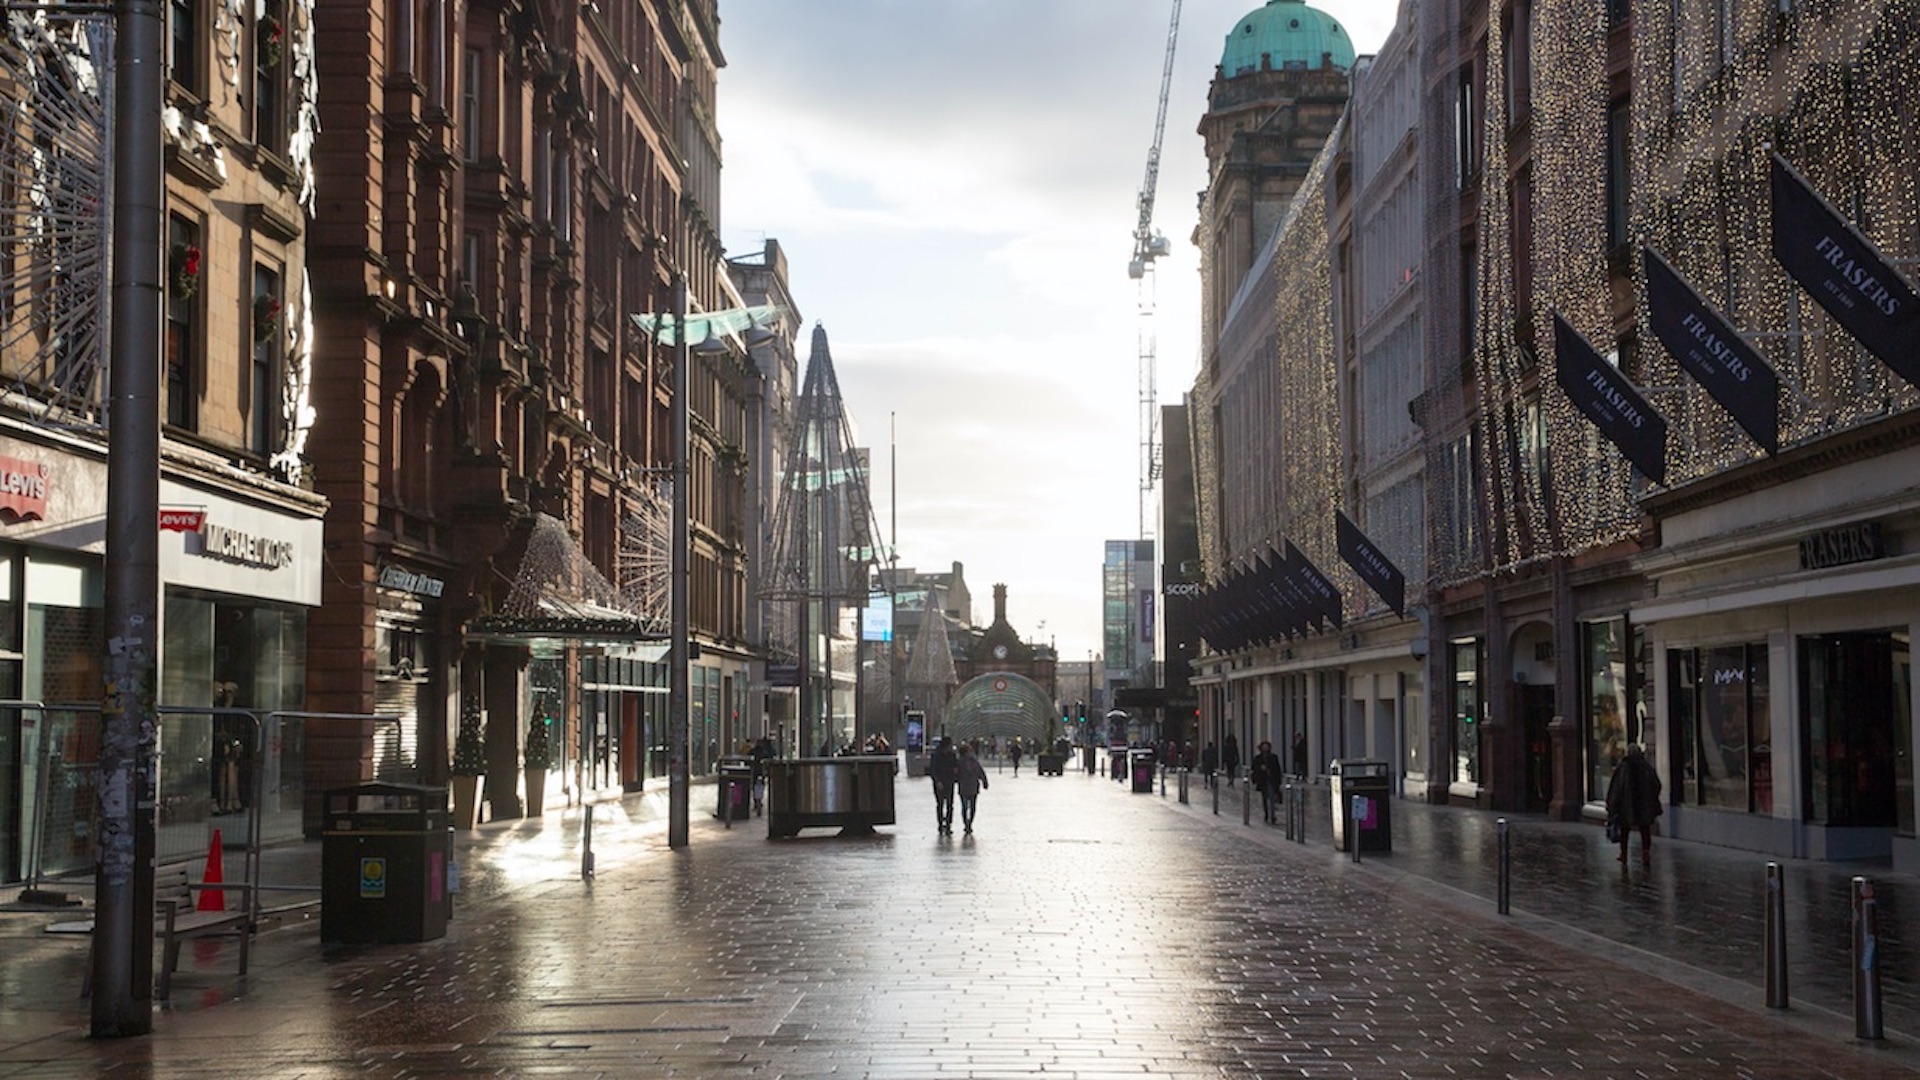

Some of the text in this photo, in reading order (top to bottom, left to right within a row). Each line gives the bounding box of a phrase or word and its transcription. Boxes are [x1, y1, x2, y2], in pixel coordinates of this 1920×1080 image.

[1815, 236, 1900, 315] FRASERS
[1682, 313, 1752, 382] FRASERS
[1586, 369, 1646, 429] FRASERS
[204, 524, 294, 568] MICHAEL KORS
